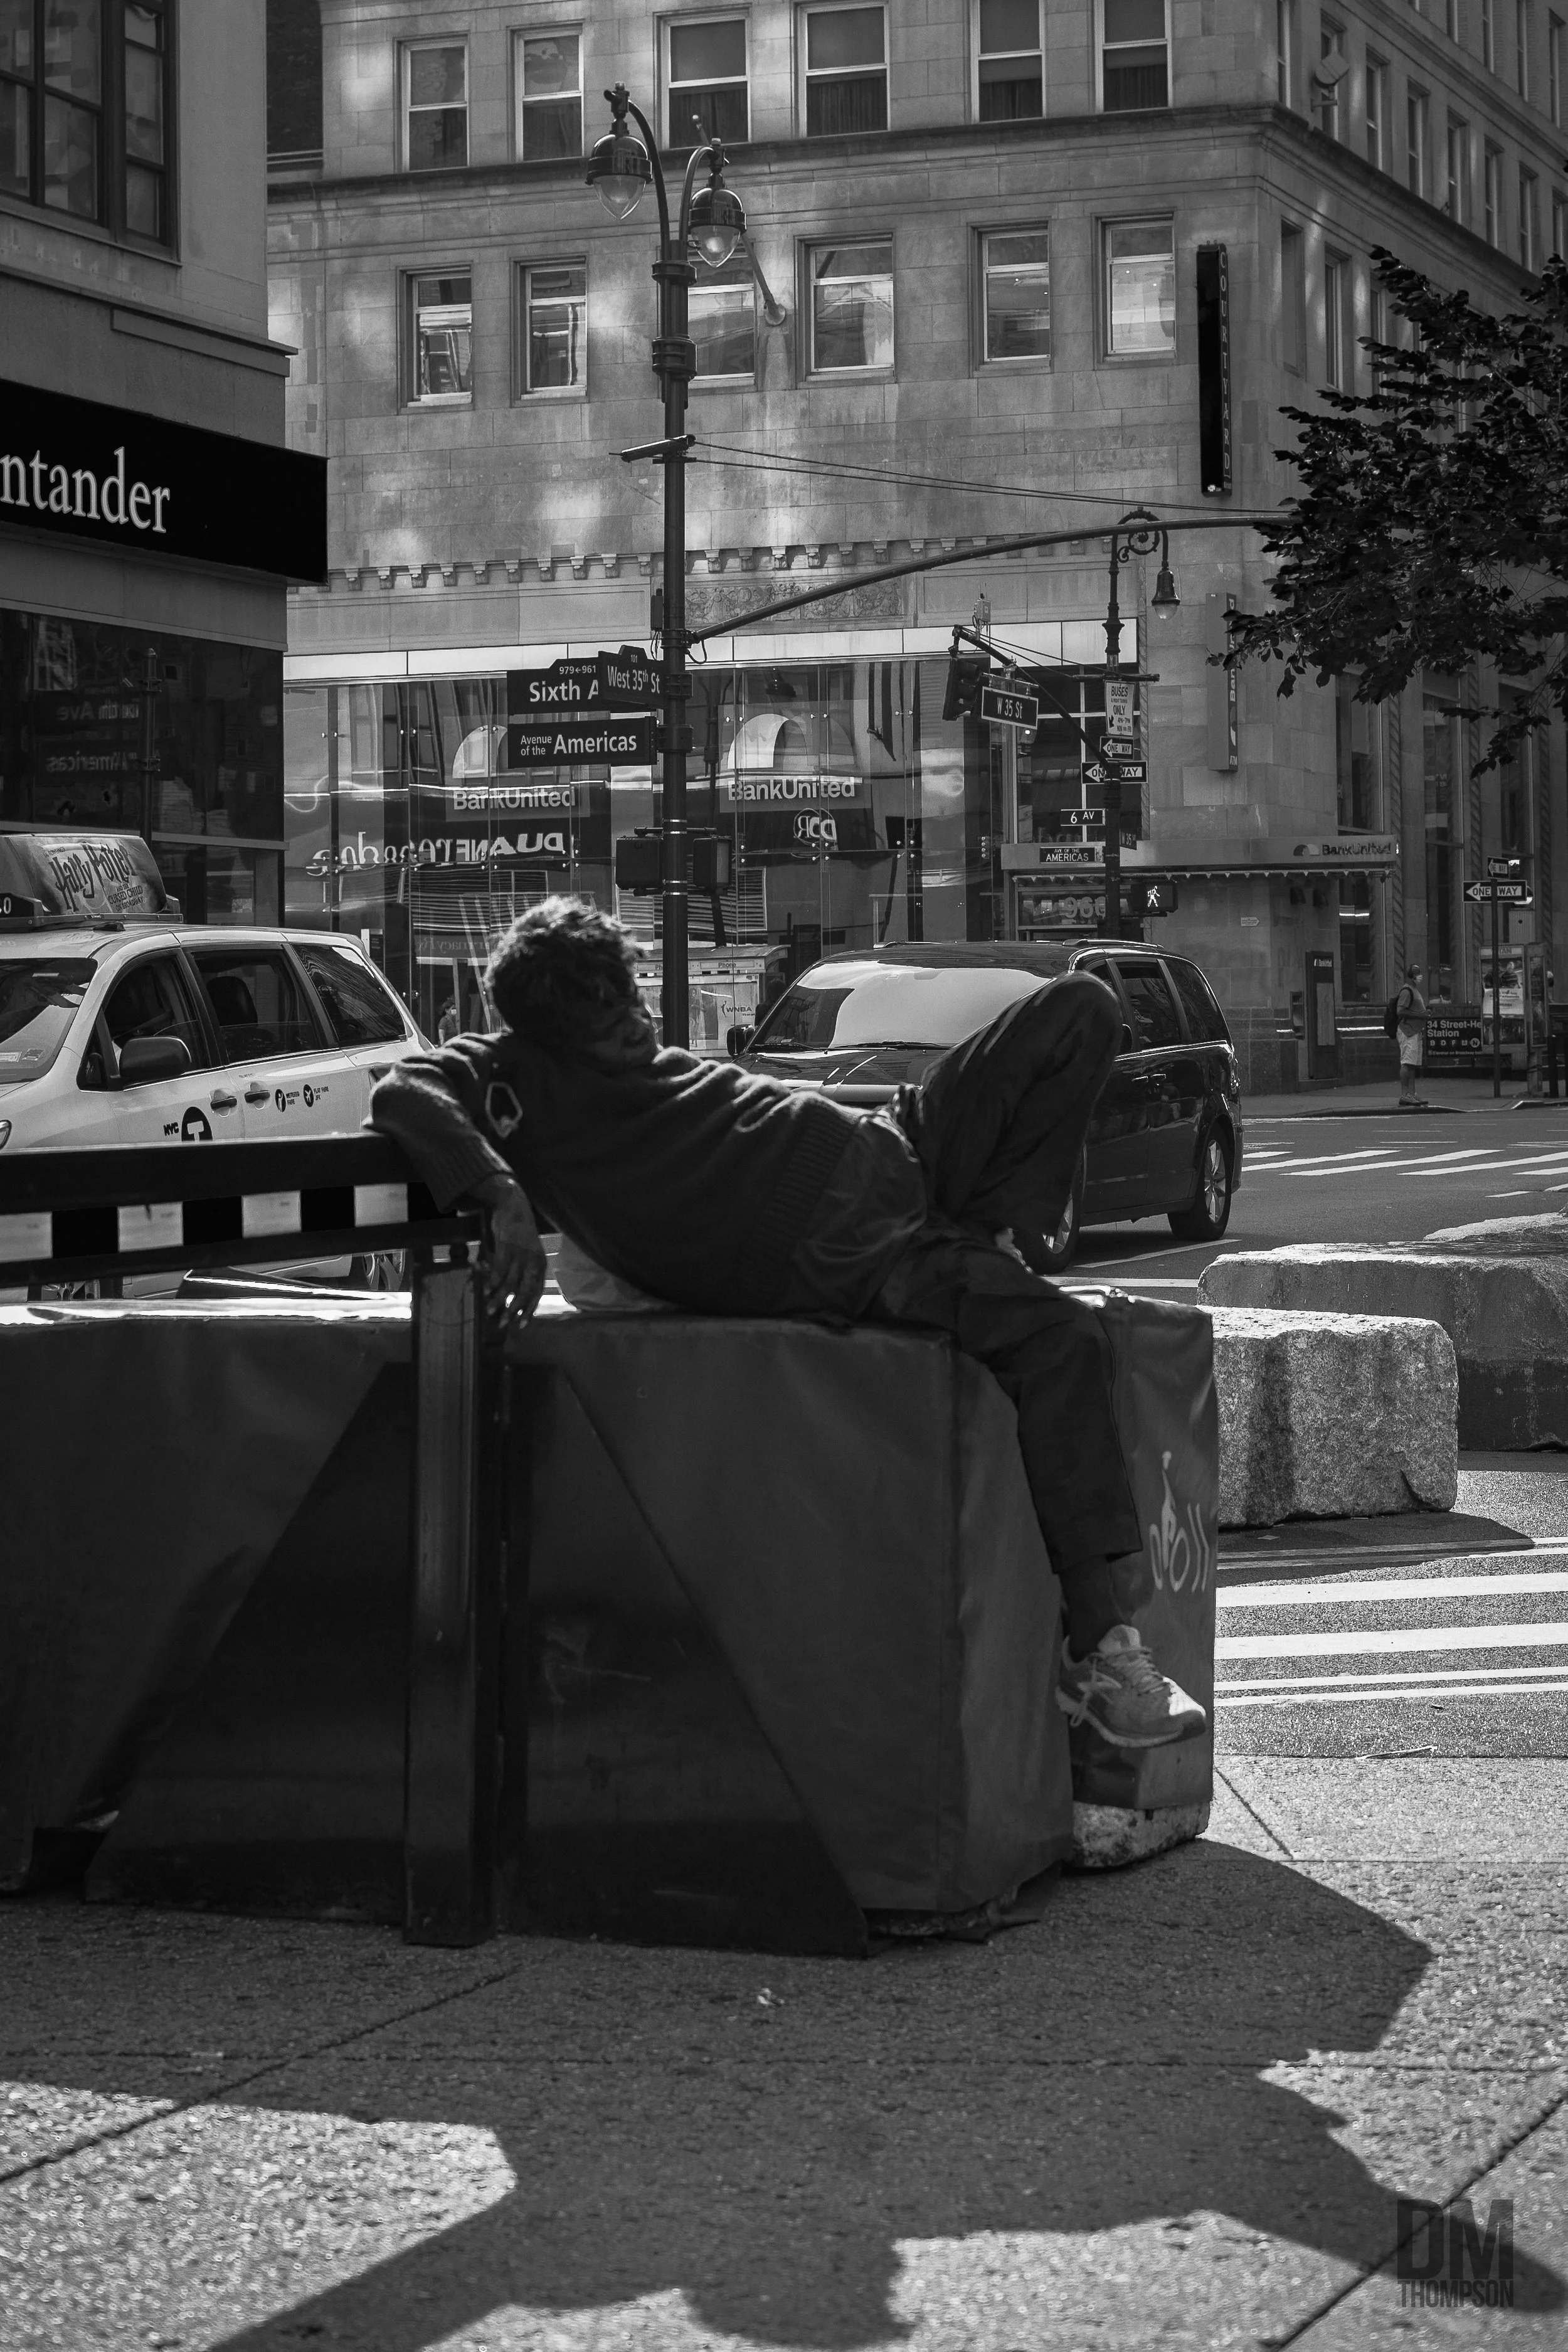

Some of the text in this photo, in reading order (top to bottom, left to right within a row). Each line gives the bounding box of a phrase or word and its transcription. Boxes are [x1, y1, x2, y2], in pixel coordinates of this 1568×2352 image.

[1221, 252, 1229, 469] COURTYARD
[0, 446, 171, 533] ntander
[559, 665, 596, 675] 979 961
[607, 665, 660, 694] West 35th St
[529, 679, 580, 702] Sixth
[1111, 686, 1128, 697] BUSES
[997, 697, 1023, 719] W 35 St
[1113, 705, 1126, 715] ONLY
[521, 734, 553, 745] Avenue
[553, 731, 637, 755] Americas
[521, 744, 546, 756] of the
[1107, 743, 1131, 753] ONE WAY
[1091, 767, 1105, 778] ON
[728, 778, 856, 801] BankUnited
[453, 786, 575, 810] BankUnited
[1070, 812, 1094, 824] 6 AV
[1126, 833, 1132, 845] 35
[1322, 842, 1391, 856] BankUnited
[1046, 853, 1089, 862] AMERICAS
[48, 841, 137, 913] Harry Potter
[108, 885, 143, 904] CURSED CHILD
[1473, 887, 1518, 896] ONE WAY
[0, 898, 11, 914] 0
[1427, 1020, 1482, 1029] 34 Street-He
[1427, 1029, 1459, 1037] Station
[163, 1120, 204, 1142] NYC T
